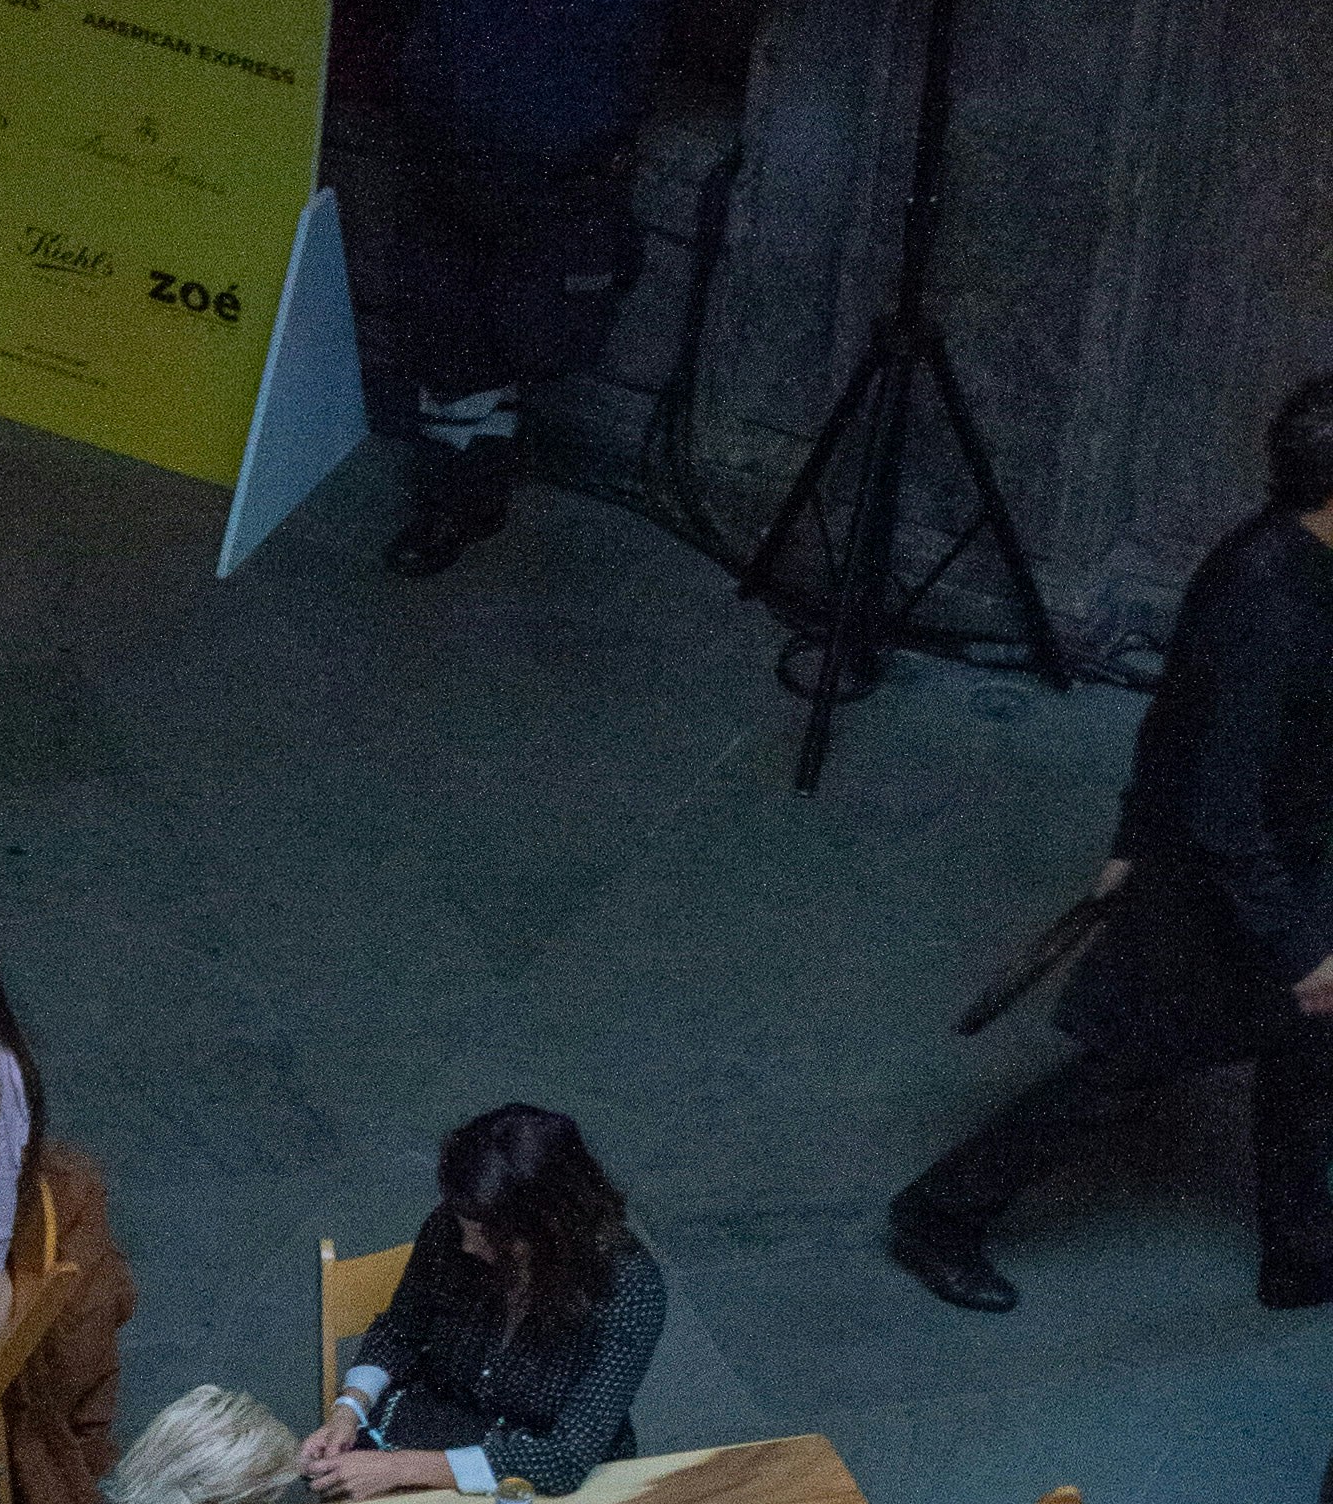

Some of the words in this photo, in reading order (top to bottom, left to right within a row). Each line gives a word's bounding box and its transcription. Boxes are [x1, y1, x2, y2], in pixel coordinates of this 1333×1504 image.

[80, 11, 193, 57] AMERICAN
[197, 44, 297, 86] EXPRESS
[148, 269, 243, 324] zoé
